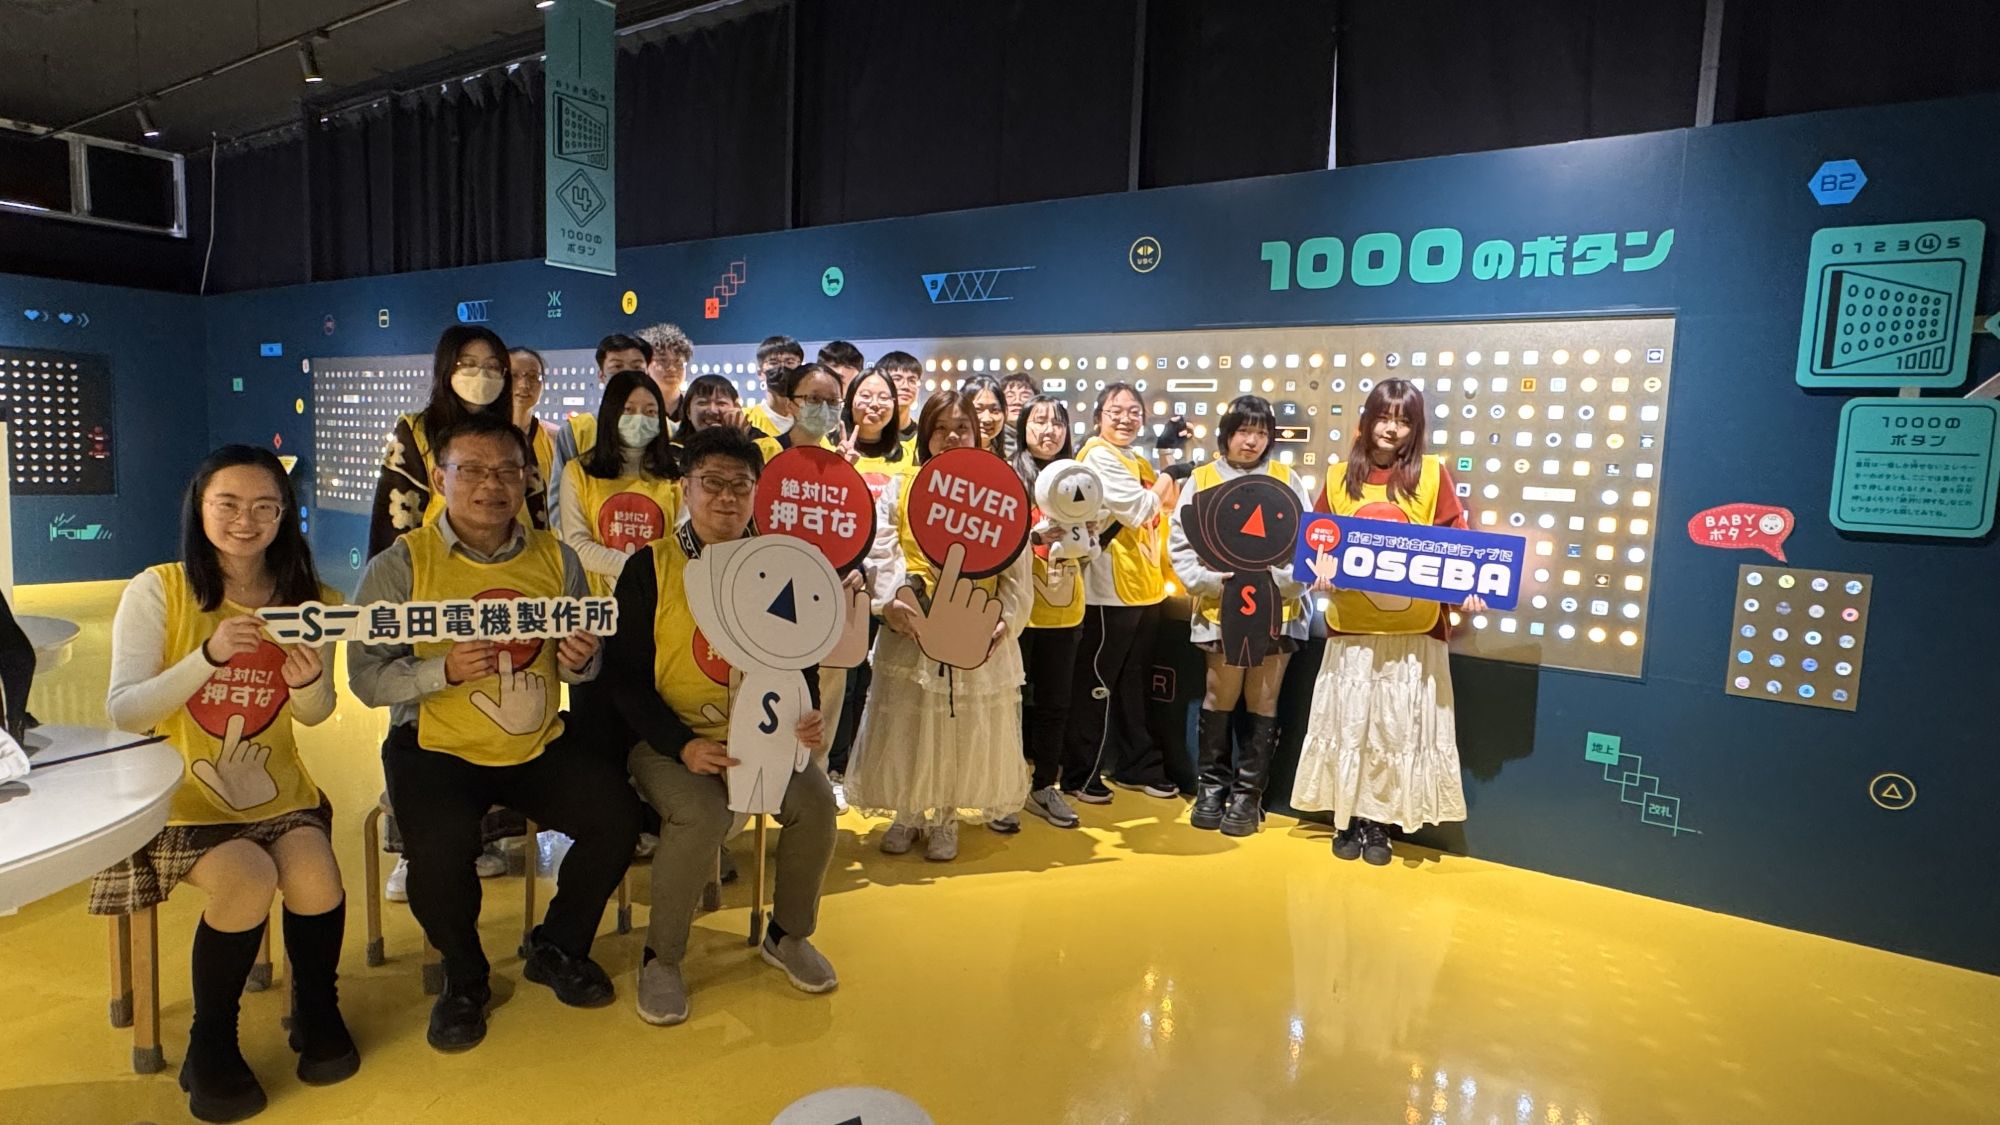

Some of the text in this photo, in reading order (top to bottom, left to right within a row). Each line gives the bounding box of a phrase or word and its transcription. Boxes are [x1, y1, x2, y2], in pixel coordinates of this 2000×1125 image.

[1820, 173, 1857, 192] B2
[572, 185, 592, 212] 4
[561, 228, 602, 244] 1000の
[567, 243, 596, 256] ボタン
[1260, 227, 1675, 291] 1000のボタン
[1896, 346, 1946, 370] 1000
[1881, 416, 1961, 429] 1000の
[1890, 434, 1946, 447] ボタン
[781, 477, 848, 505] 絶対に!
[927, 469, 1018, 521] NEVER
[609, 522, 654, 539] 押すな
[770, 500, 857, 538] 押すな
[926, 502, 1003, 548] PUSH
[1705, 514, 1755, 527] BABY
[1072, 526, 1081, 542] S
[1709, 527, 1758, 541] ボタン
[1342, 546, 1511, 597] OSEBA
[1239, 585, 1257, 616] S
[369, 601, 614, 639] 島田電機製作所
[201, 682, 275, 708] 押すな
[758, 691, 781, 734] S
[1592, 742, 1614, 755] 地上
[1649, 803, 1673, 818] 改札
